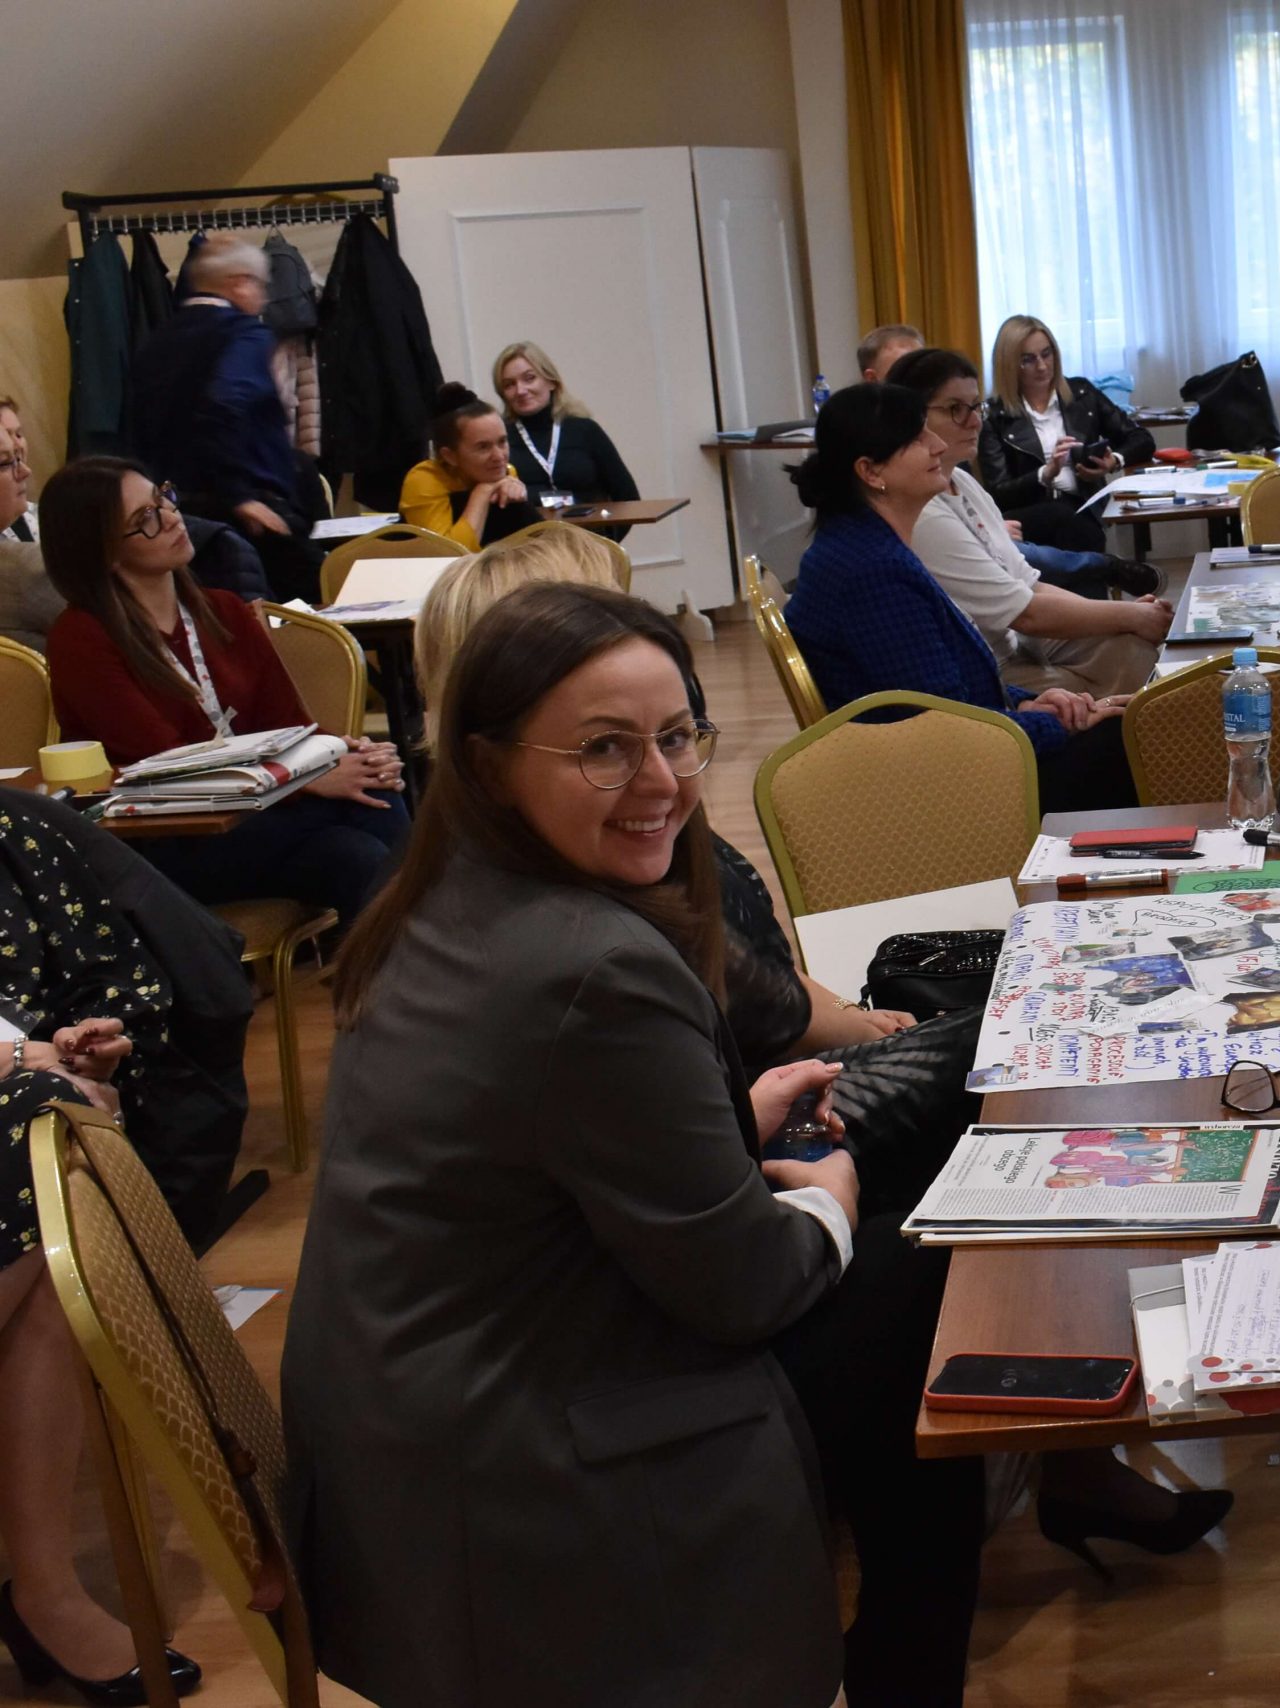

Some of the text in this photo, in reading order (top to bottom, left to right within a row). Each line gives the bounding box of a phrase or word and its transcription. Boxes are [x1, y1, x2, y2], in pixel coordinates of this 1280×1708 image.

[993, 1149, 1016, 1172] obcego
[1003, 1137, 1041, 1185] Lekcje polskiego
